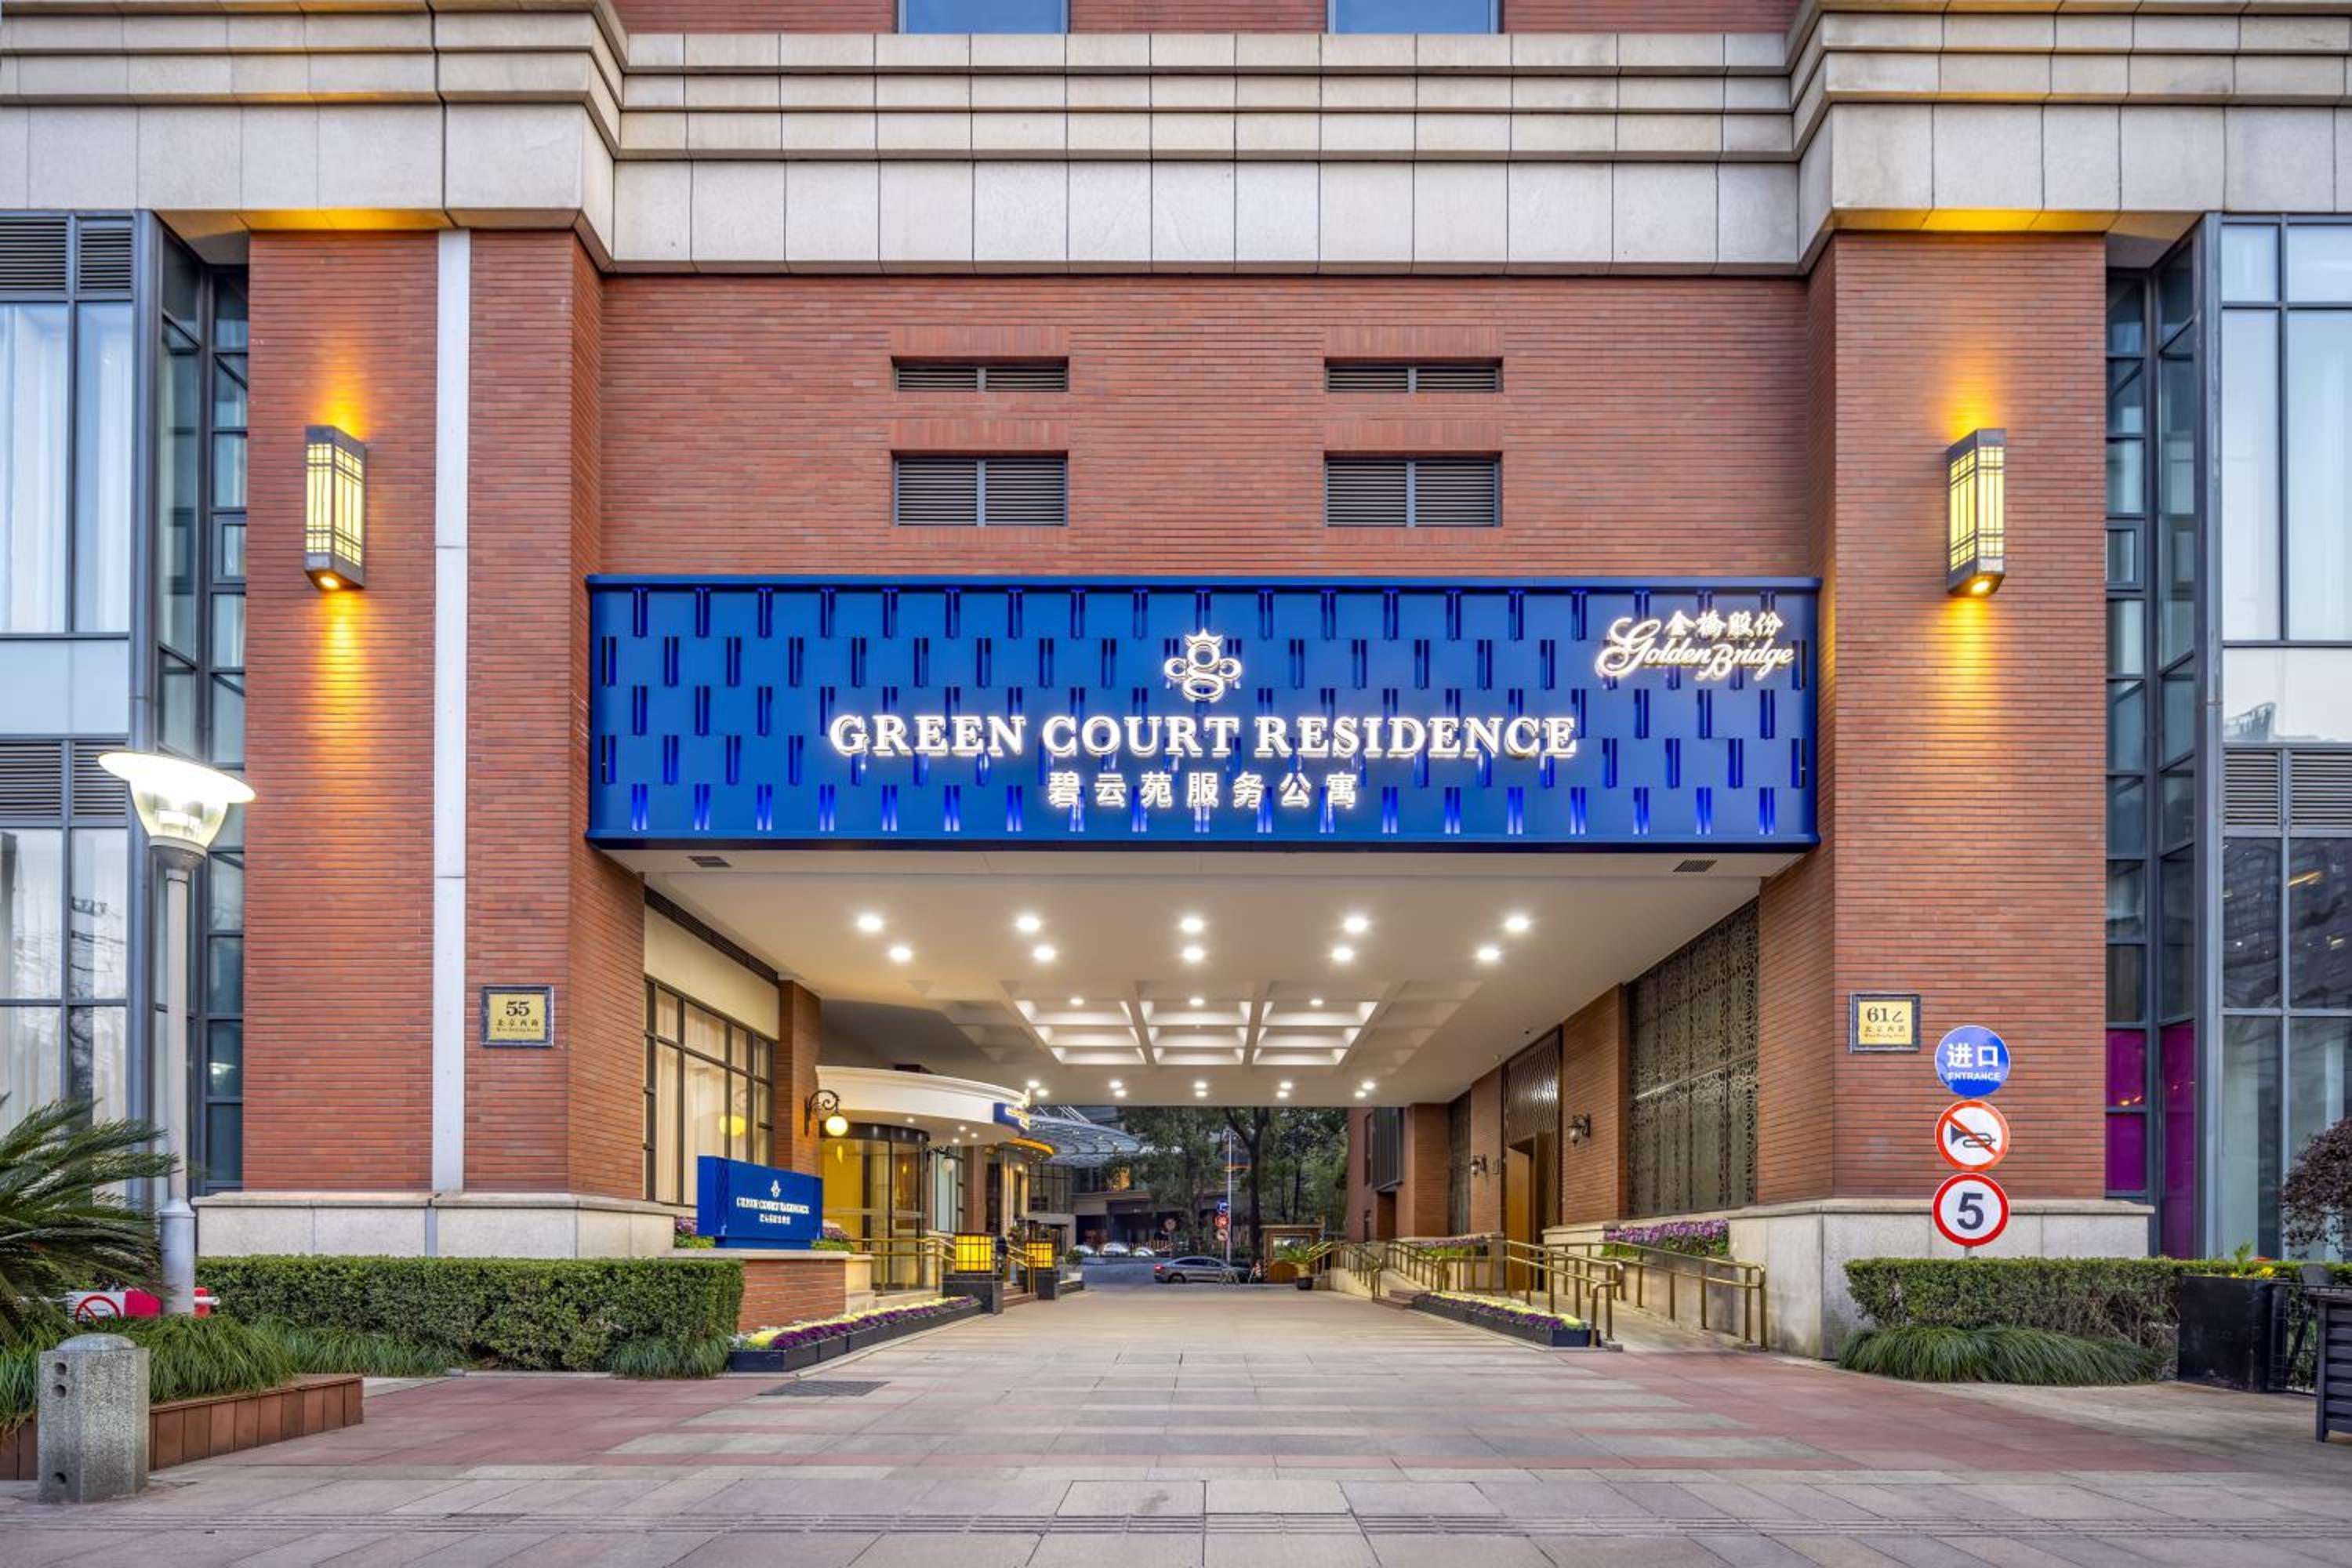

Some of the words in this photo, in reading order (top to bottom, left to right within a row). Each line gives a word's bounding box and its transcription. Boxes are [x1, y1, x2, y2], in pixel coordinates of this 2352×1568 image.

[829, 714, 1026, 757] GREEN
[1042, 716, 1240, 757] COURT
[1254, 716, 1577, 758] RESIDENCE
[1047, 771, 1357, 808] 碧云苑服务公寓
[506, 1000, 531, 1017] 55
[1947, 1042, 1998, 1068] 进口
[1947, 1072, 2001, 1080] ENTRANCE
[1957, 1192, 1984, 1230] 5
